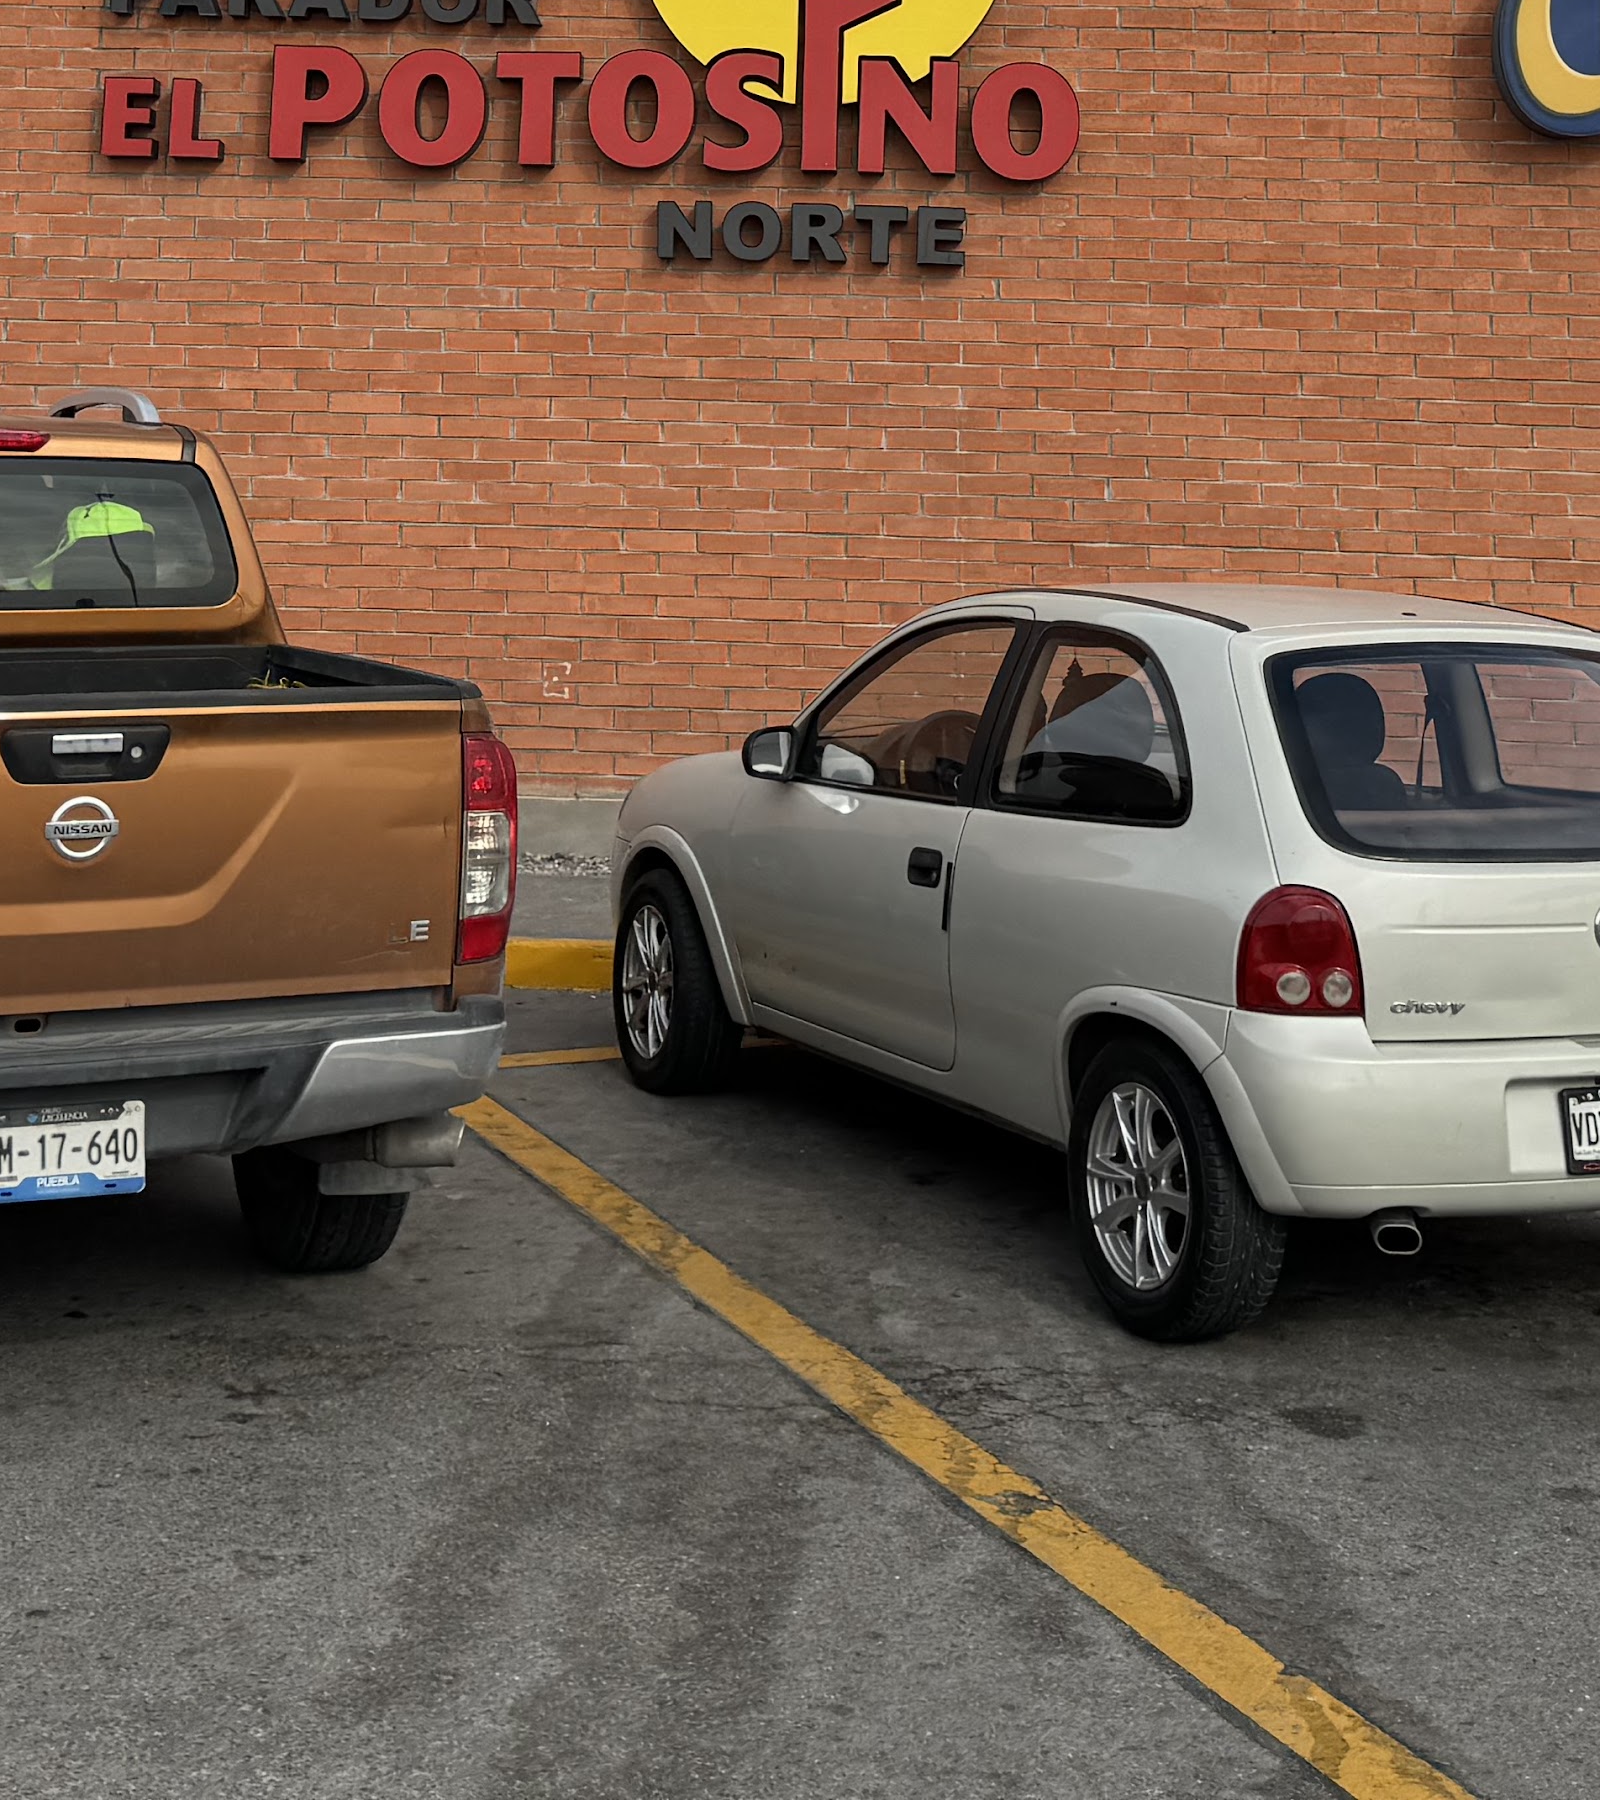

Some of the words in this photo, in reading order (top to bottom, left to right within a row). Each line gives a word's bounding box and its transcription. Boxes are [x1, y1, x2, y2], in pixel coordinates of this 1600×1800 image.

[99, 75, 225, 161] EL
[266, 44, 1080, 181] POTOSINO
[655, 199, 967, 267] NORTE
[53, 823, 112, 835] NISSAN
[36, 1174, 80, 1188] PUEBLA
